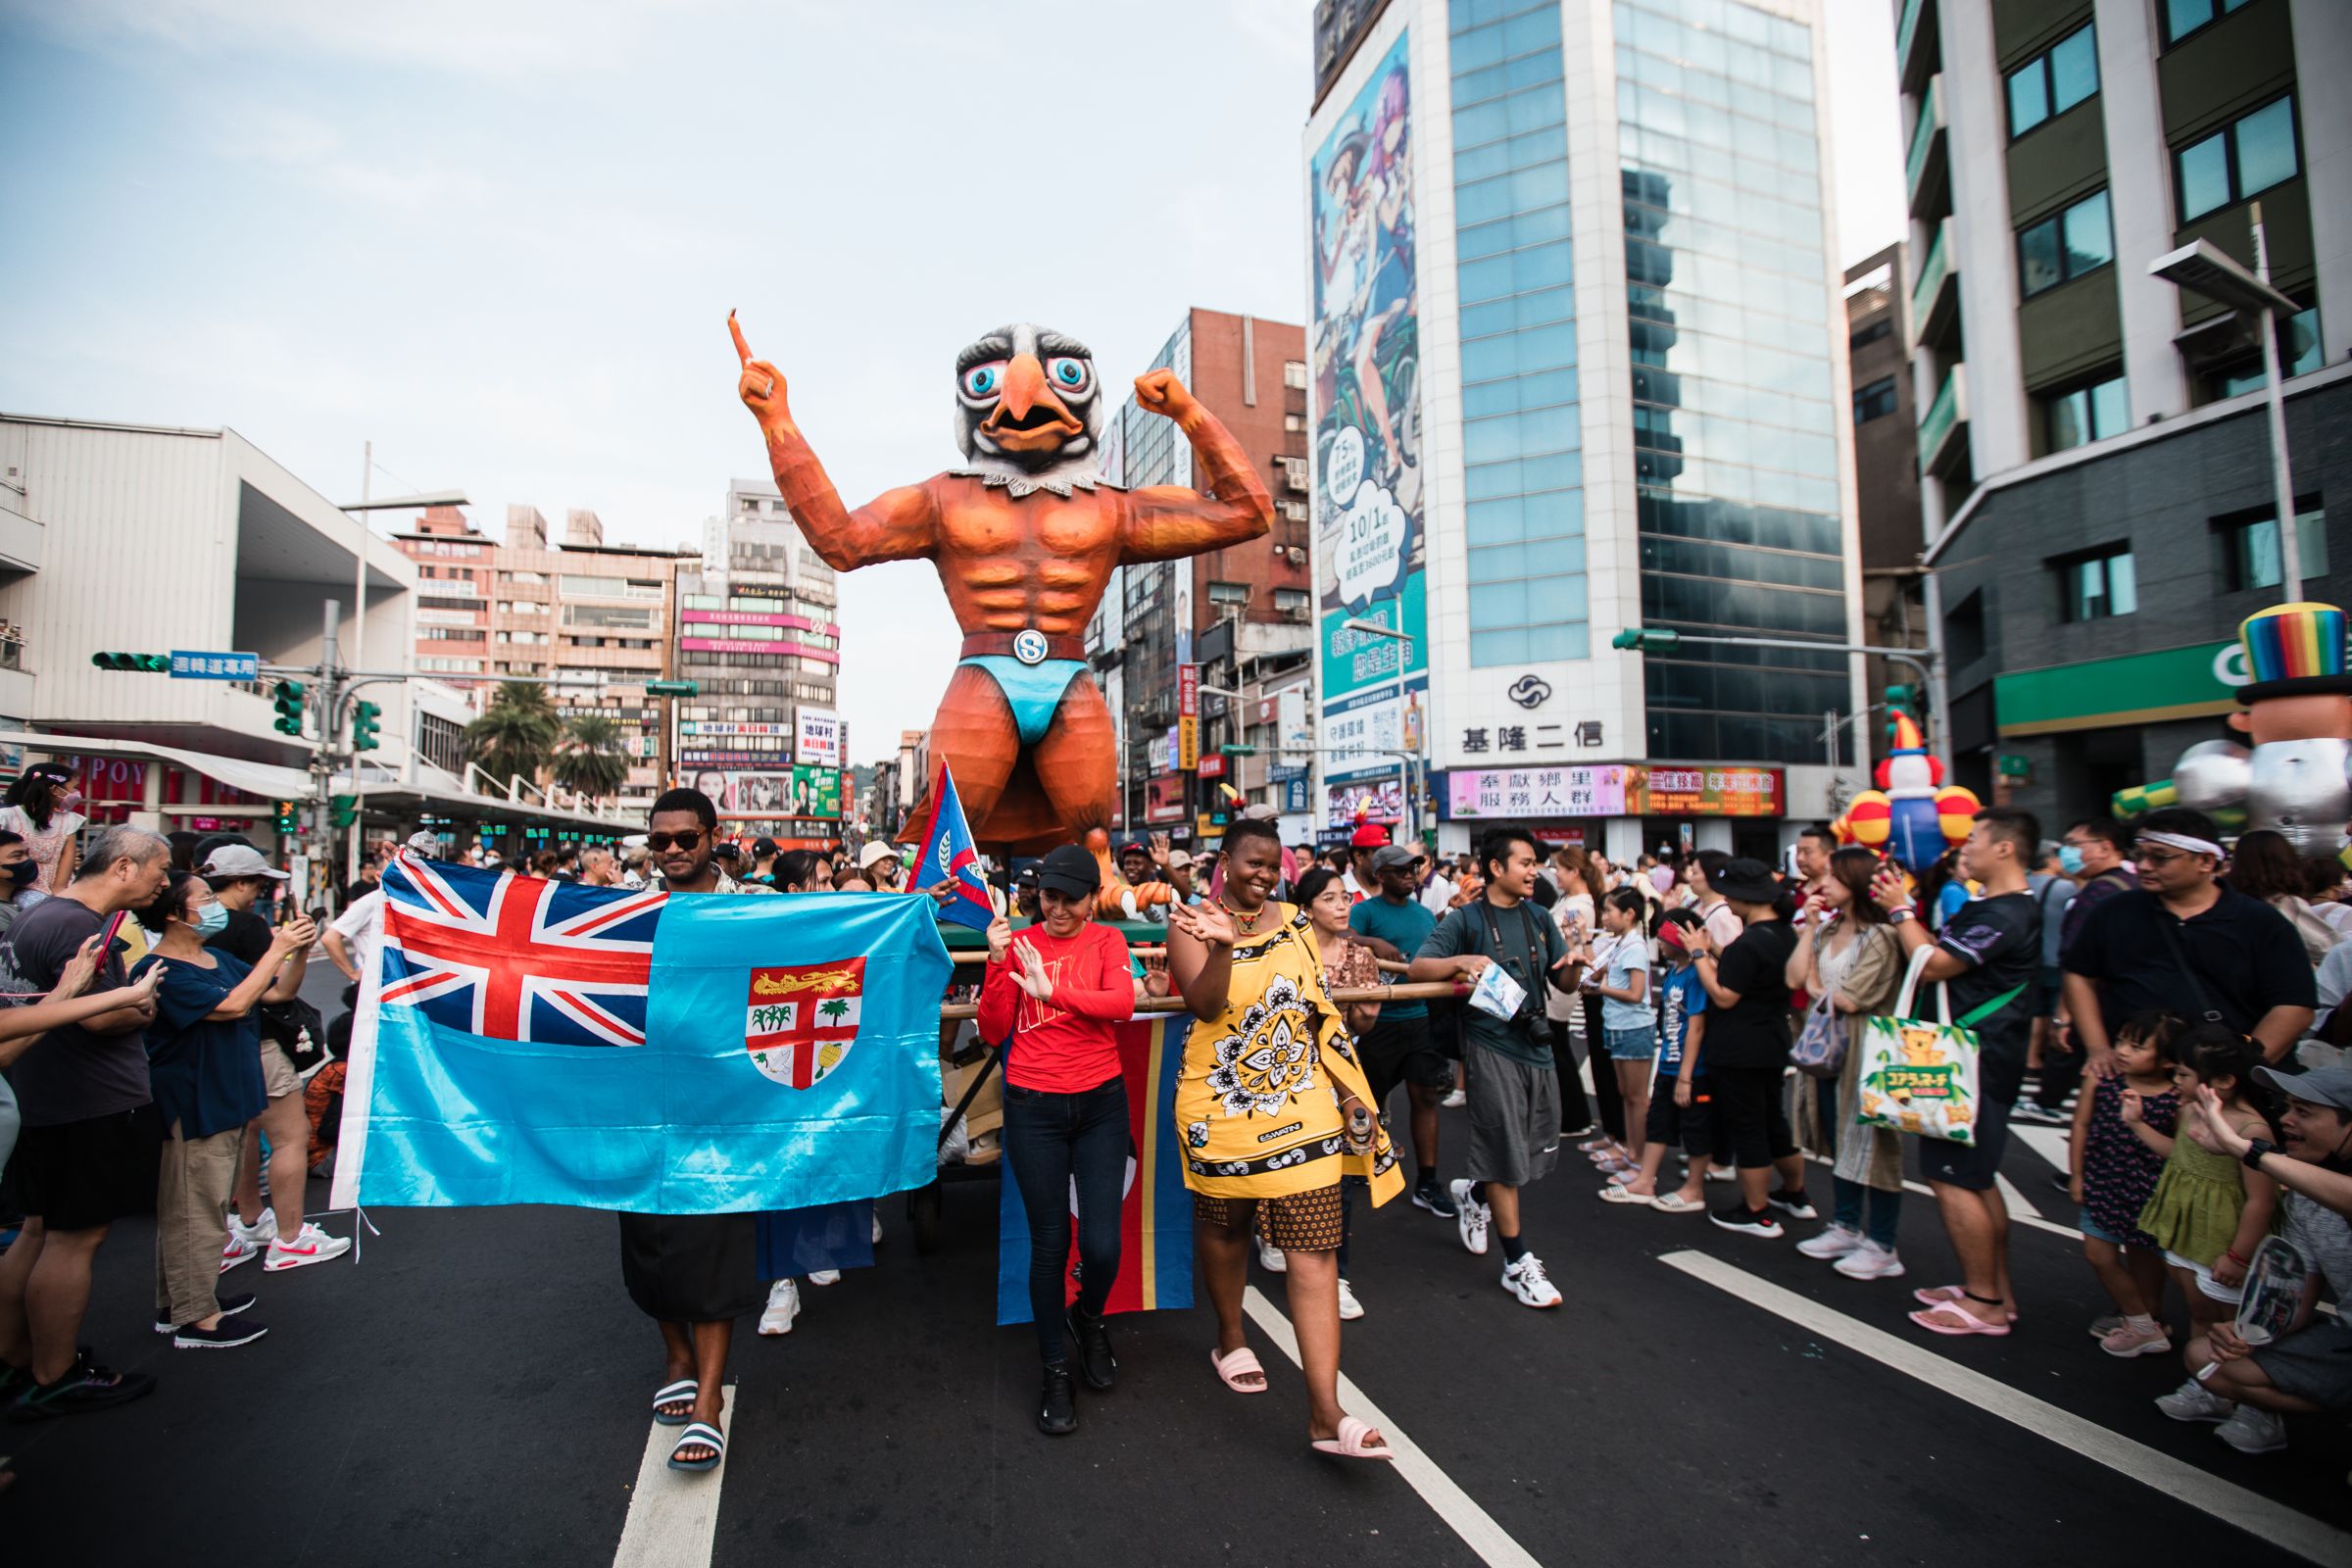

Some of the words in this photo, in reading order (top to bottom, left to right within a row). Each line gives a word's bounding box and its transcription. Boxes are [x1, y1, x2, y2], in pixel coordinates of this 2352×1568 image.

[805, 723, 833, 738] 地球村
[1462, 720, 1603, 754] 基隆二信
[1480, 770, 1592, 788] 奉獻鄉里
[1480, 790, 1592, 807] 服務人群
[1259, 1123, 1301, 1142] ESWATINI
